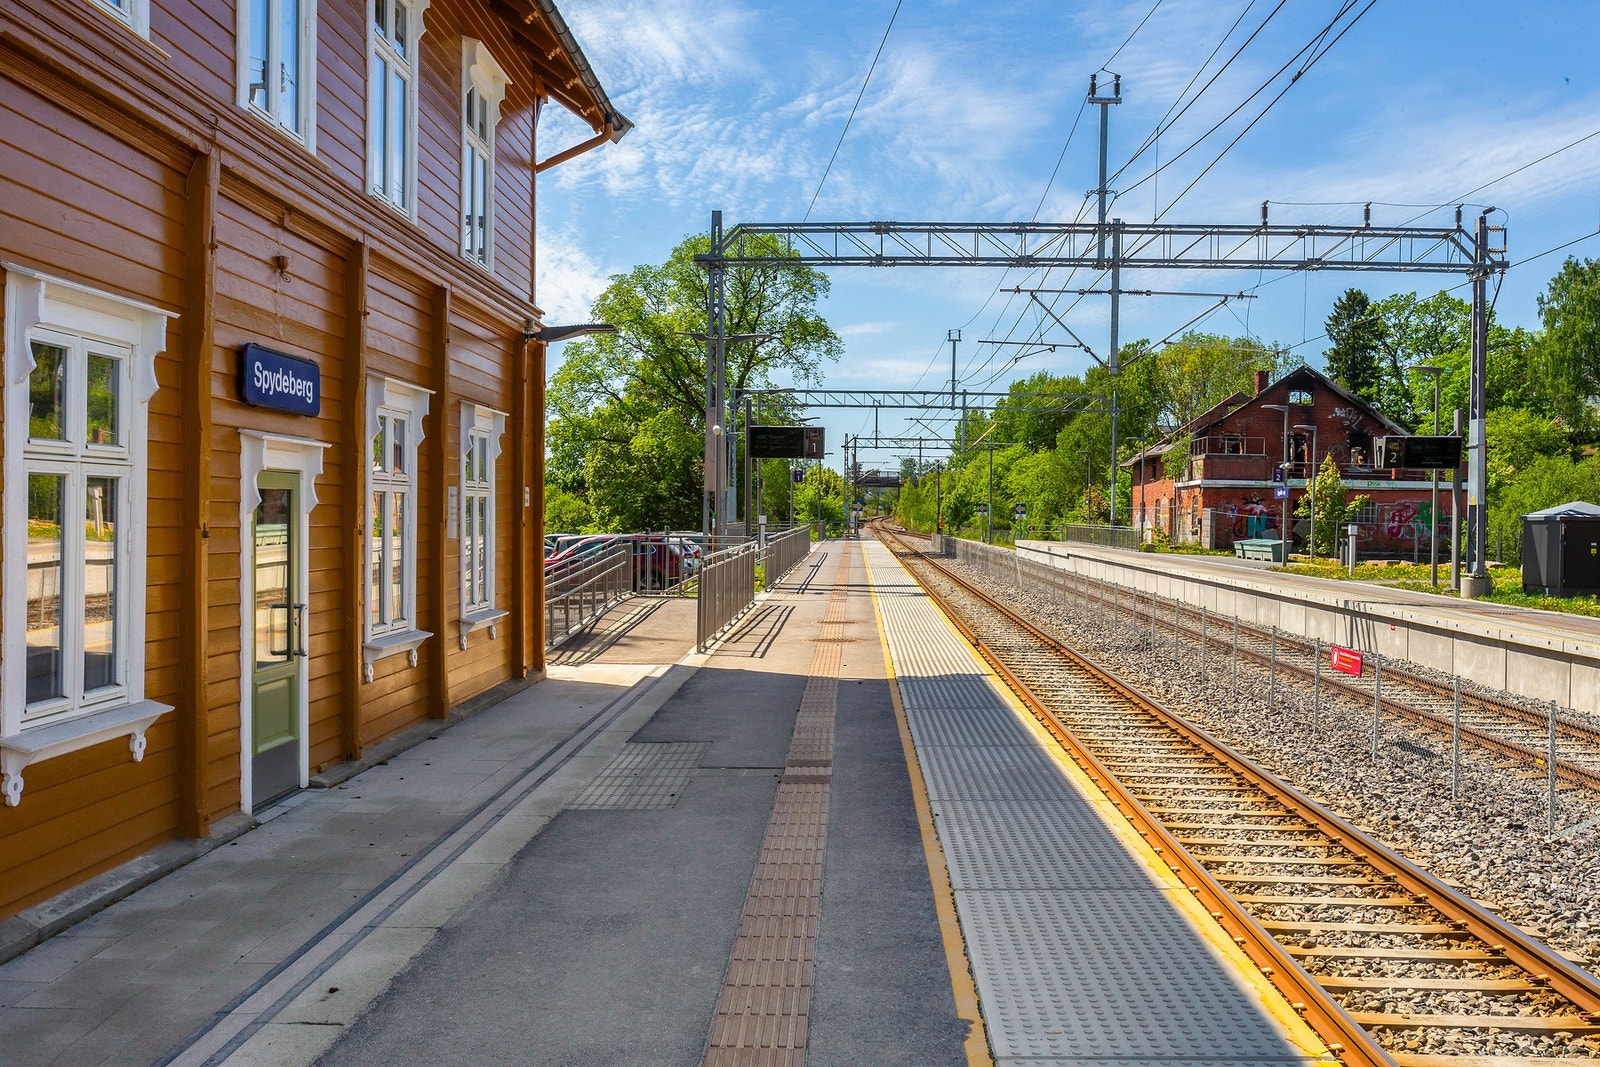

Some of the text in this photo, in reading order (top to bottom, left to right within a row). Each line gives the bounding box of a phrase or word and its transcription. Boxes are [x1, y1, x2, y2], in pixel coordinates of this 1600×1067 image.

[254, 361, 313, 403] Spydeberg
[811, 442, 817, 453] 1
[1389, 452, 1397, 463] 2
